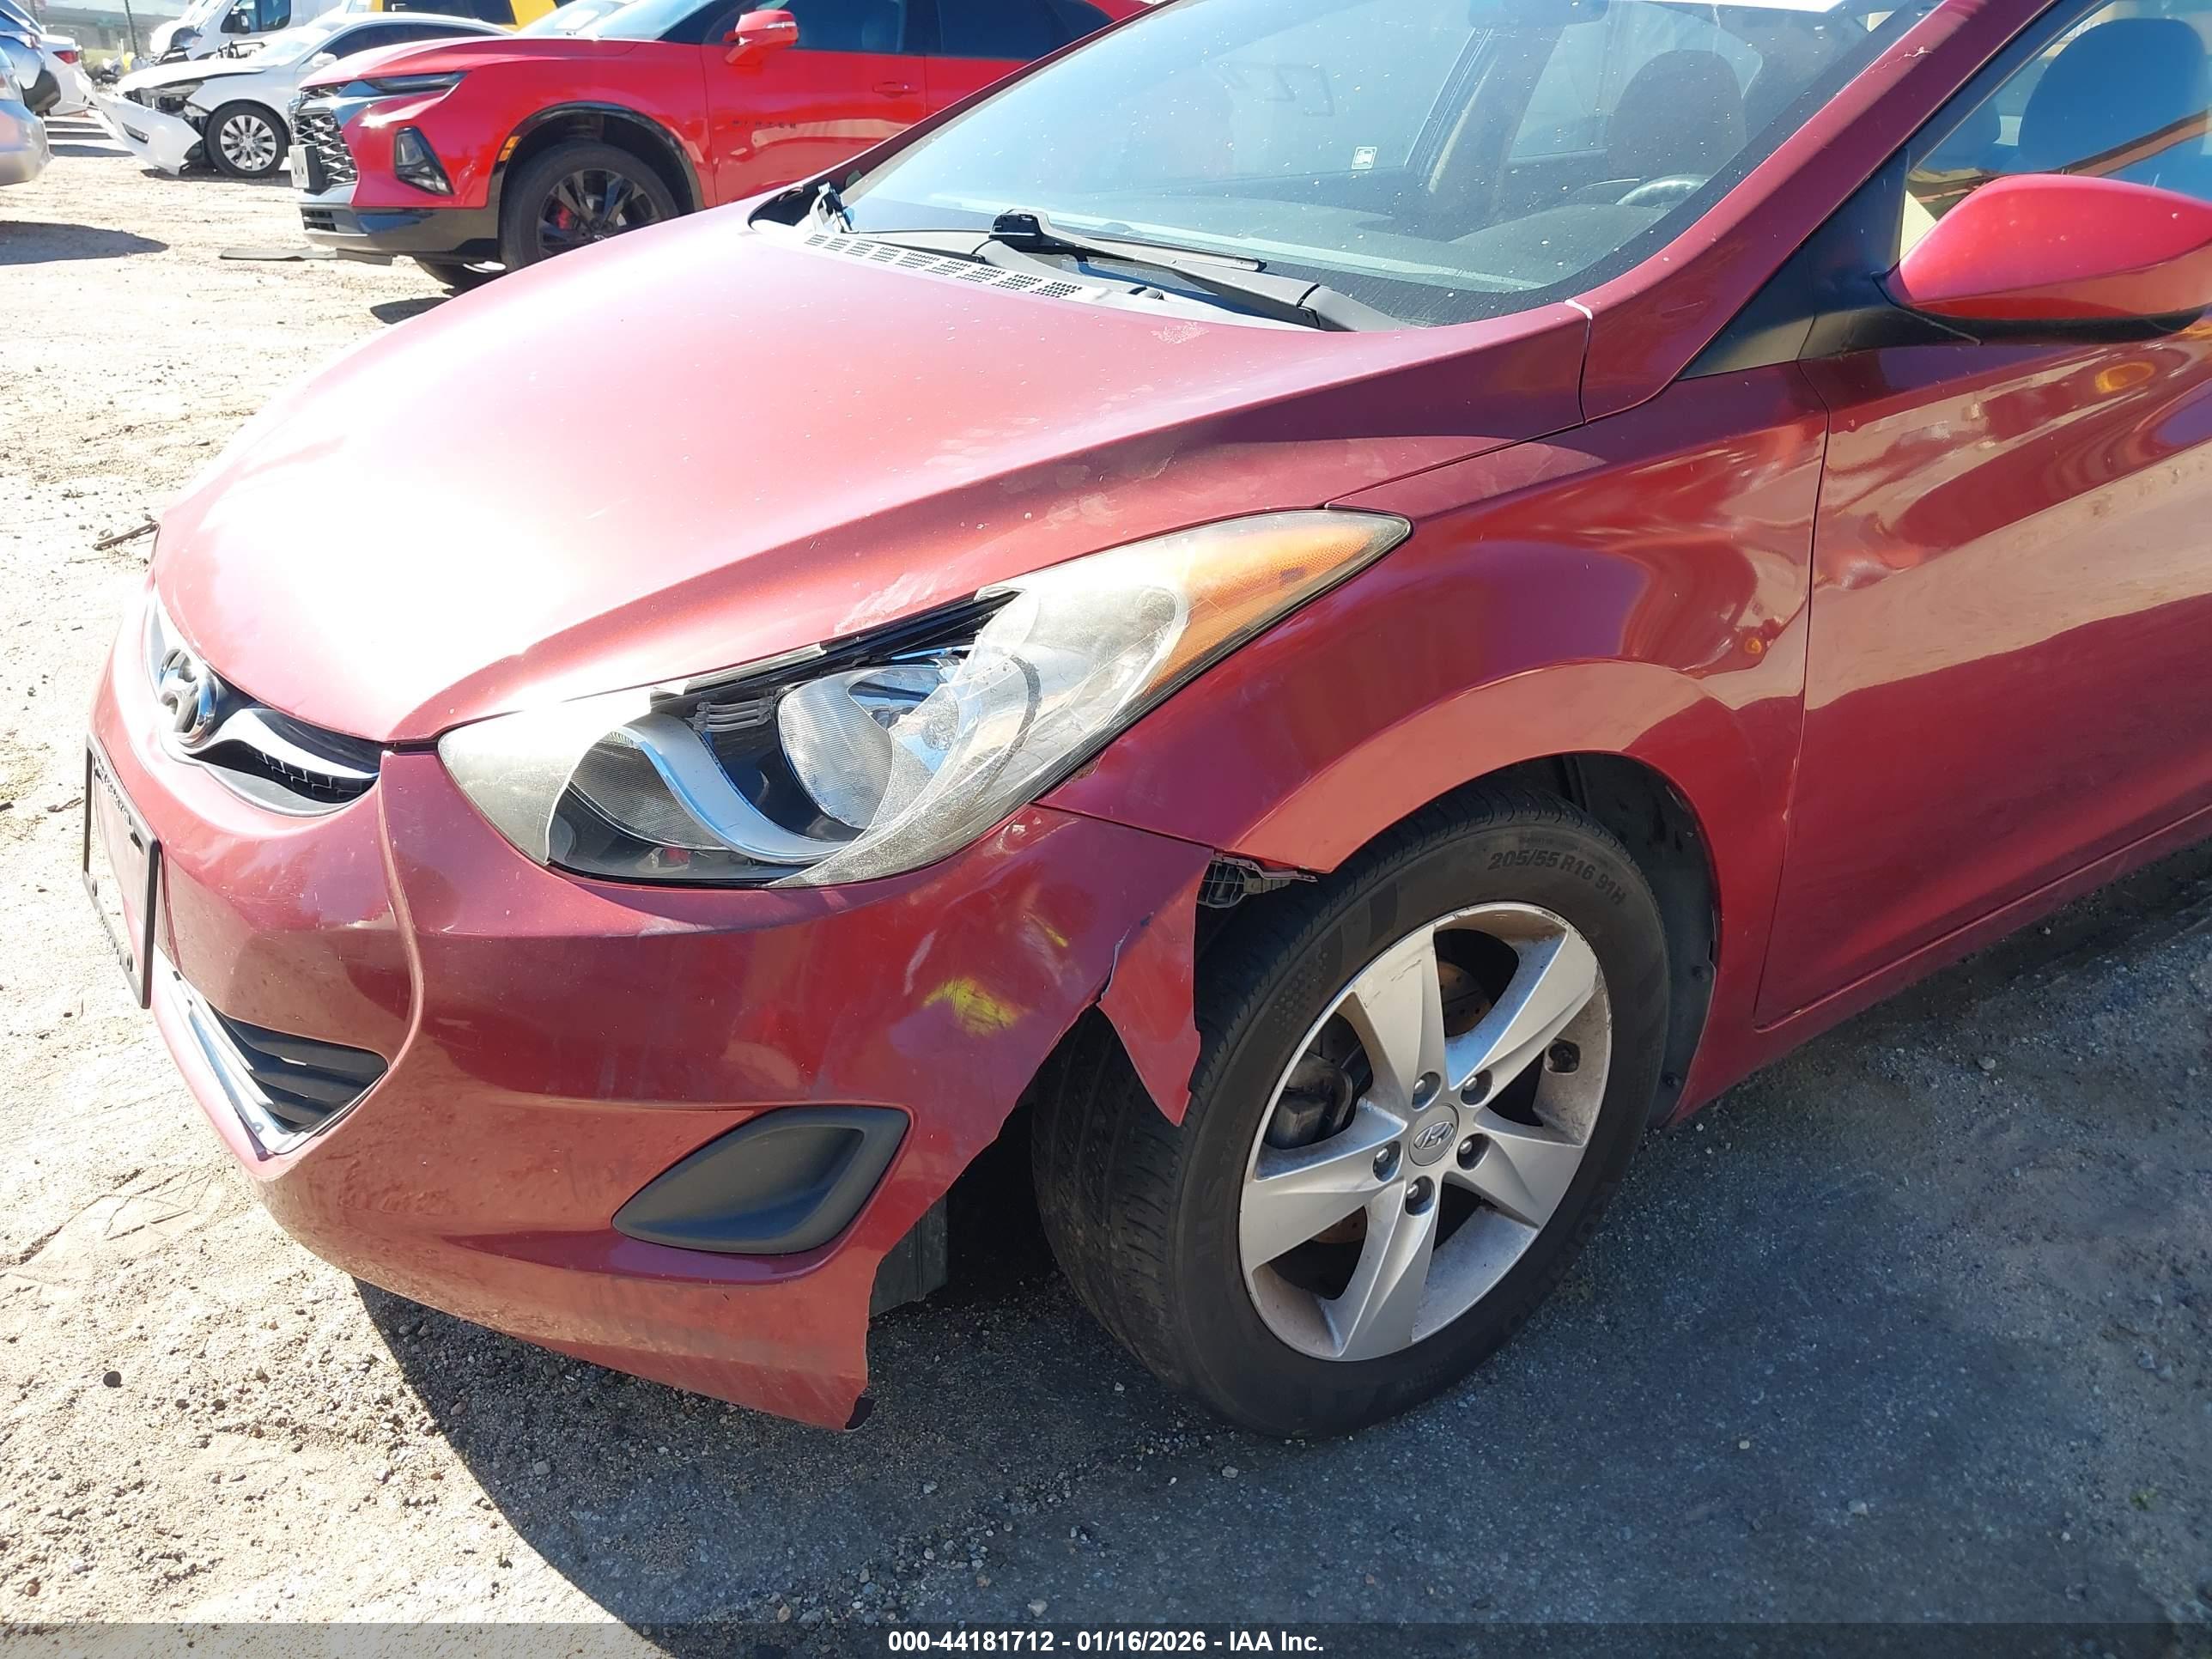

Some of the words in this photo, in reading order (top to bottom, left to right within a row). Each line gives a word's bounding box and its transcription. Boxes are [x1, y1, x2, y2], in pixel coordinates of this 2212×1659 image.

[1489, 849, 1560, 870] 205/55
[1559, 854, 1595, 880] R16
[1595, 873, 1626, 904] 91H
